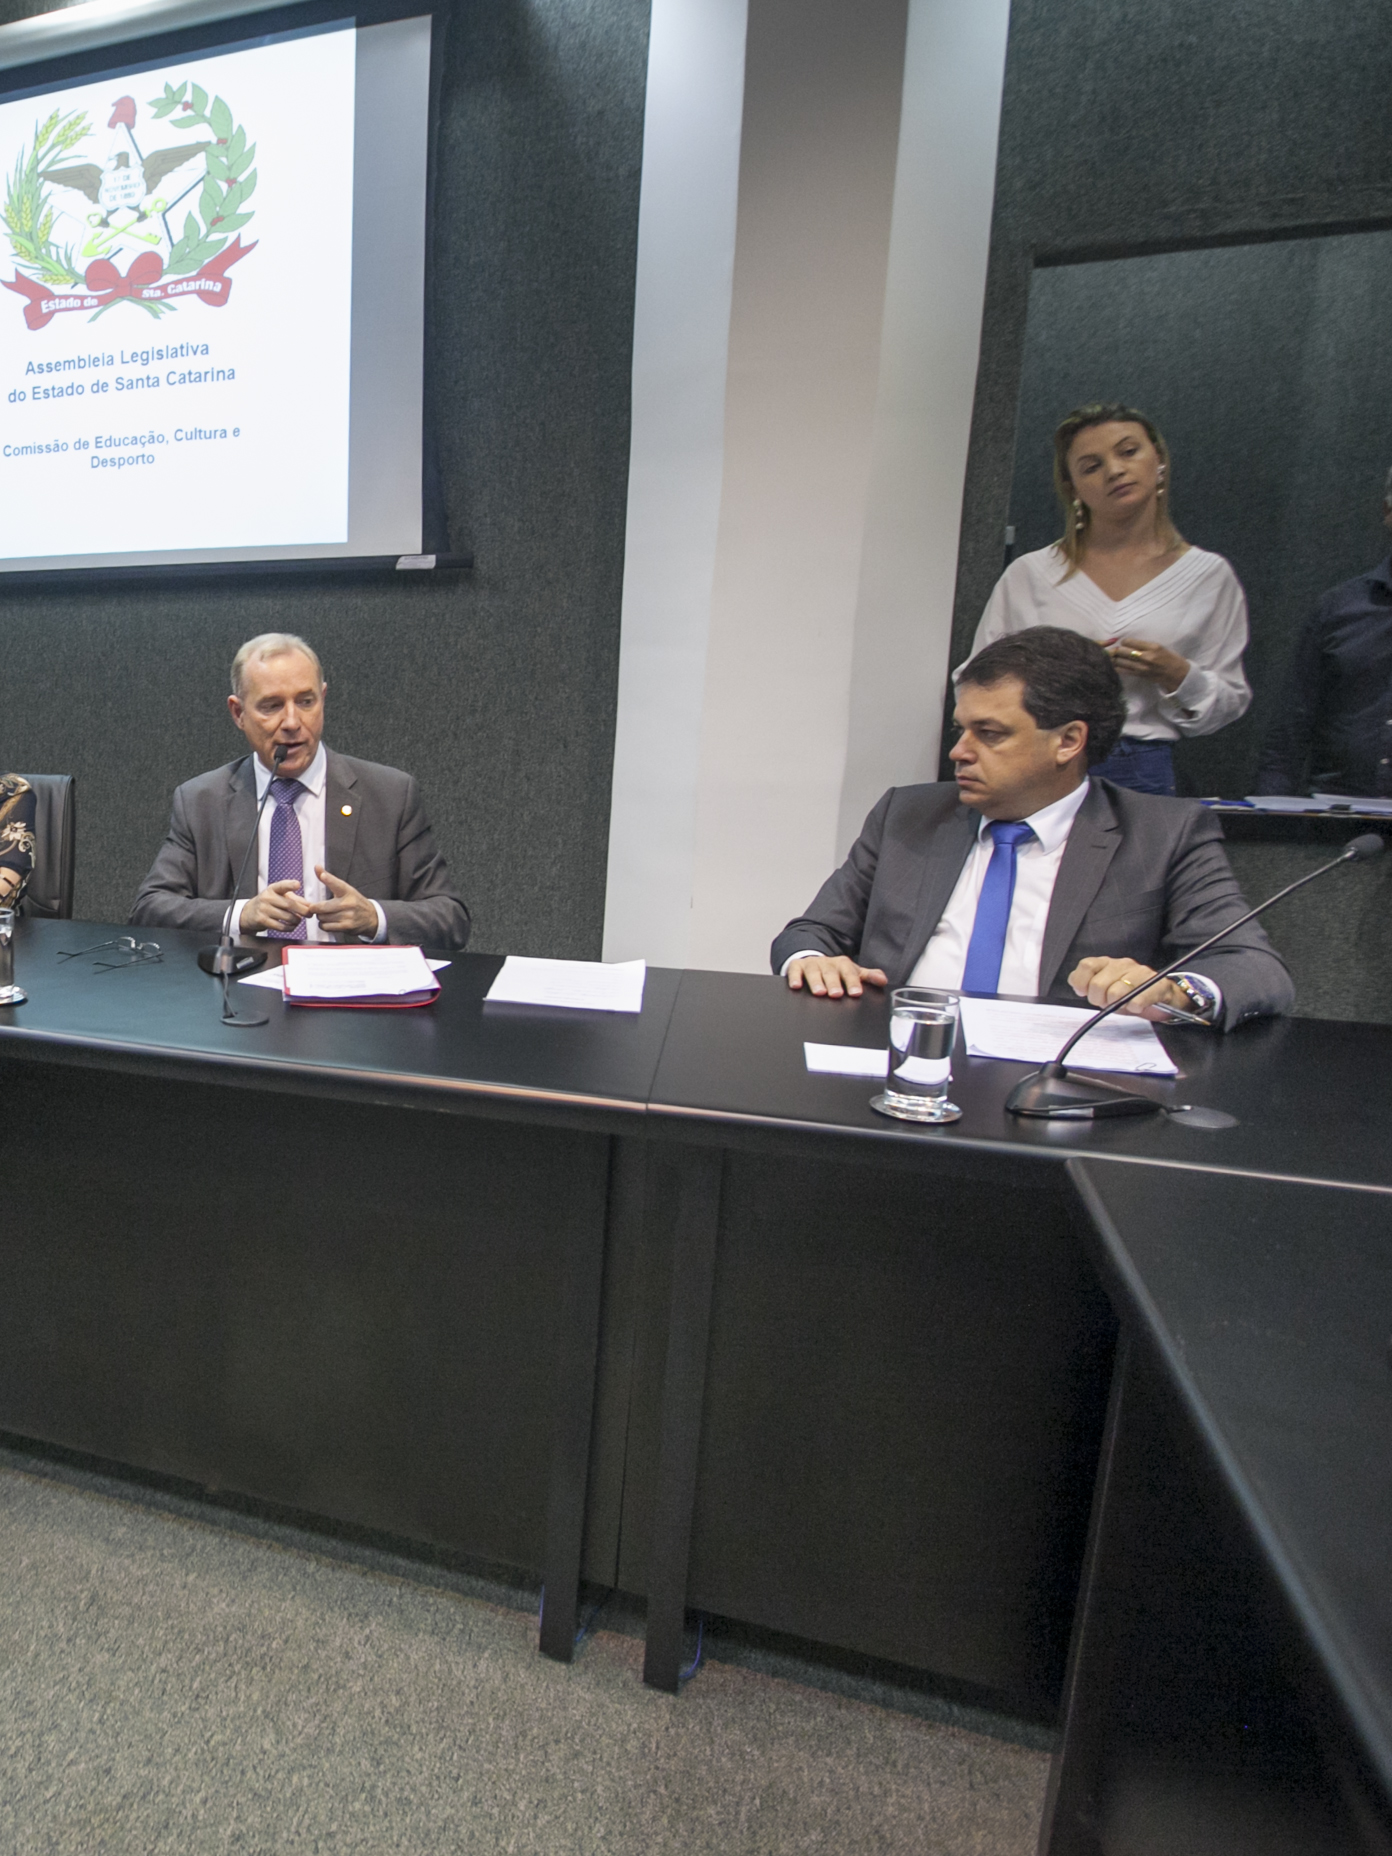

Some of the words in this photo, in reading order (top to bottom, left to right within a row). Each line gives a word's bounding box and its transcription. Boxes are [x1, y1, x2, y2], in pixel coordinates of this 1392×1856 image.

[141, 287, 164, 299] Sta.
[167, 278, 222, 296] Catarina
[40, 296, 81, 314] Estado
[83, 296, 98, 308] de
[25, 352, 114, 376] Assembleia
[120, 342, 210, 366] Legislativa
[7, 388, 27, 403] do
[32, 382, 85, 401] Estado
[90, 379, 109, 395] de
[115, 373, 160, 391] Santa
[166, 367, 236, 387] Catarina
[2, 438, 69, 458] Comissão
[73, 438, 90, 451] de
[95, 430, 169, 449] Educação,
[174, 427, 228, 443] Cultura
[232, 426, 241, 438] e
[90, 453, 155, 470] Desporto
